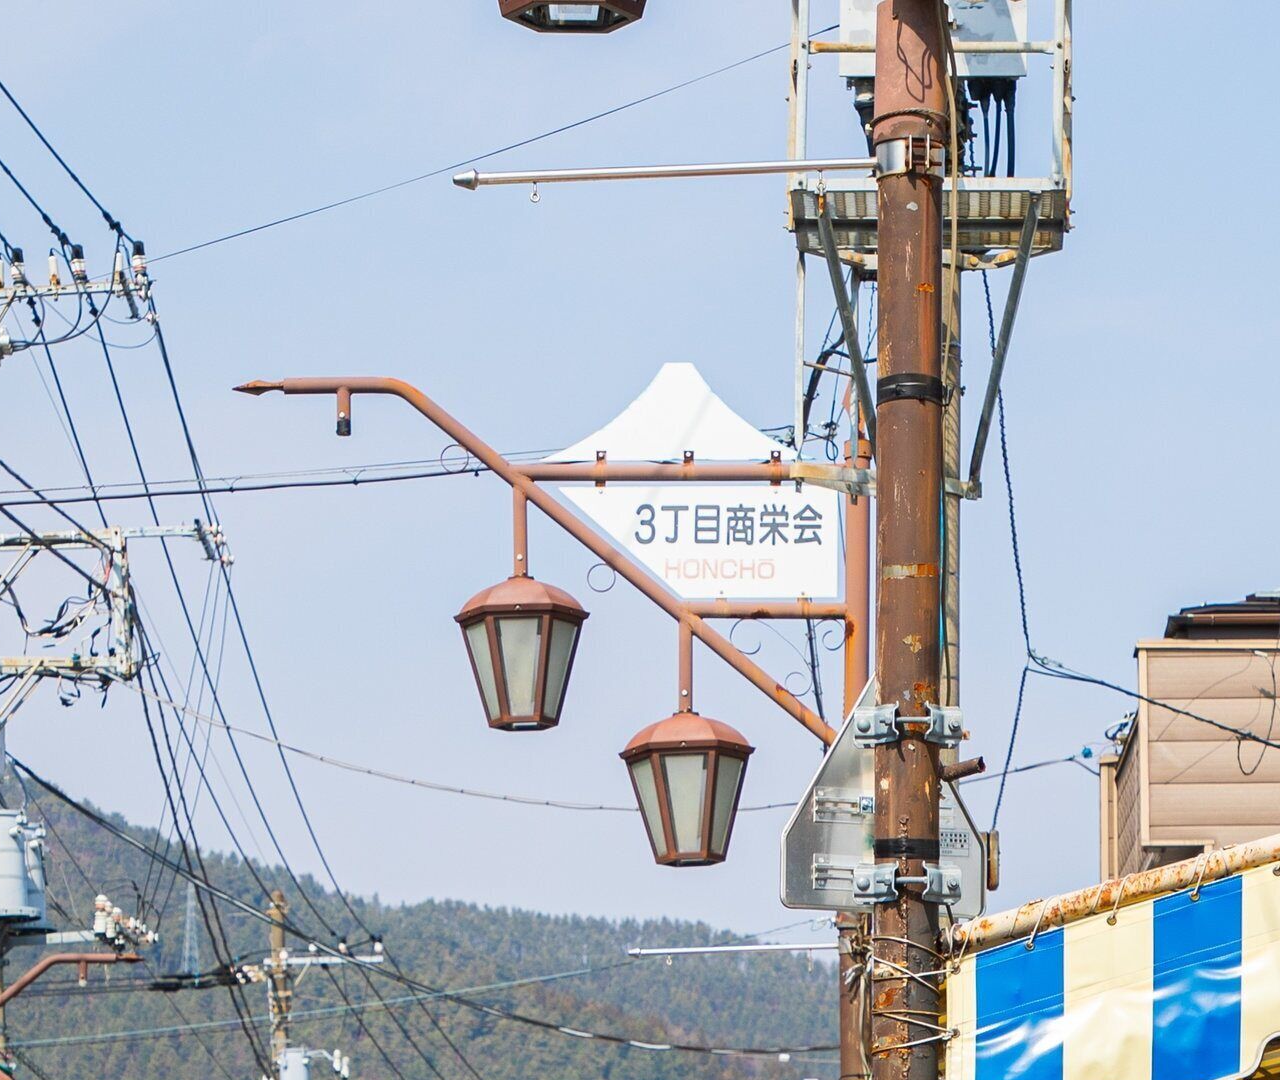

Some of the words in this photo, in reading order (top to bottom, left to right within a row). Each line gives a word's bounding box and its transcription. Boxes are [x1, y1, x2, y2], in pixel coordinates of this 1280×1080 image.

[634, 503, 824, 546] 3丁目商栄会
